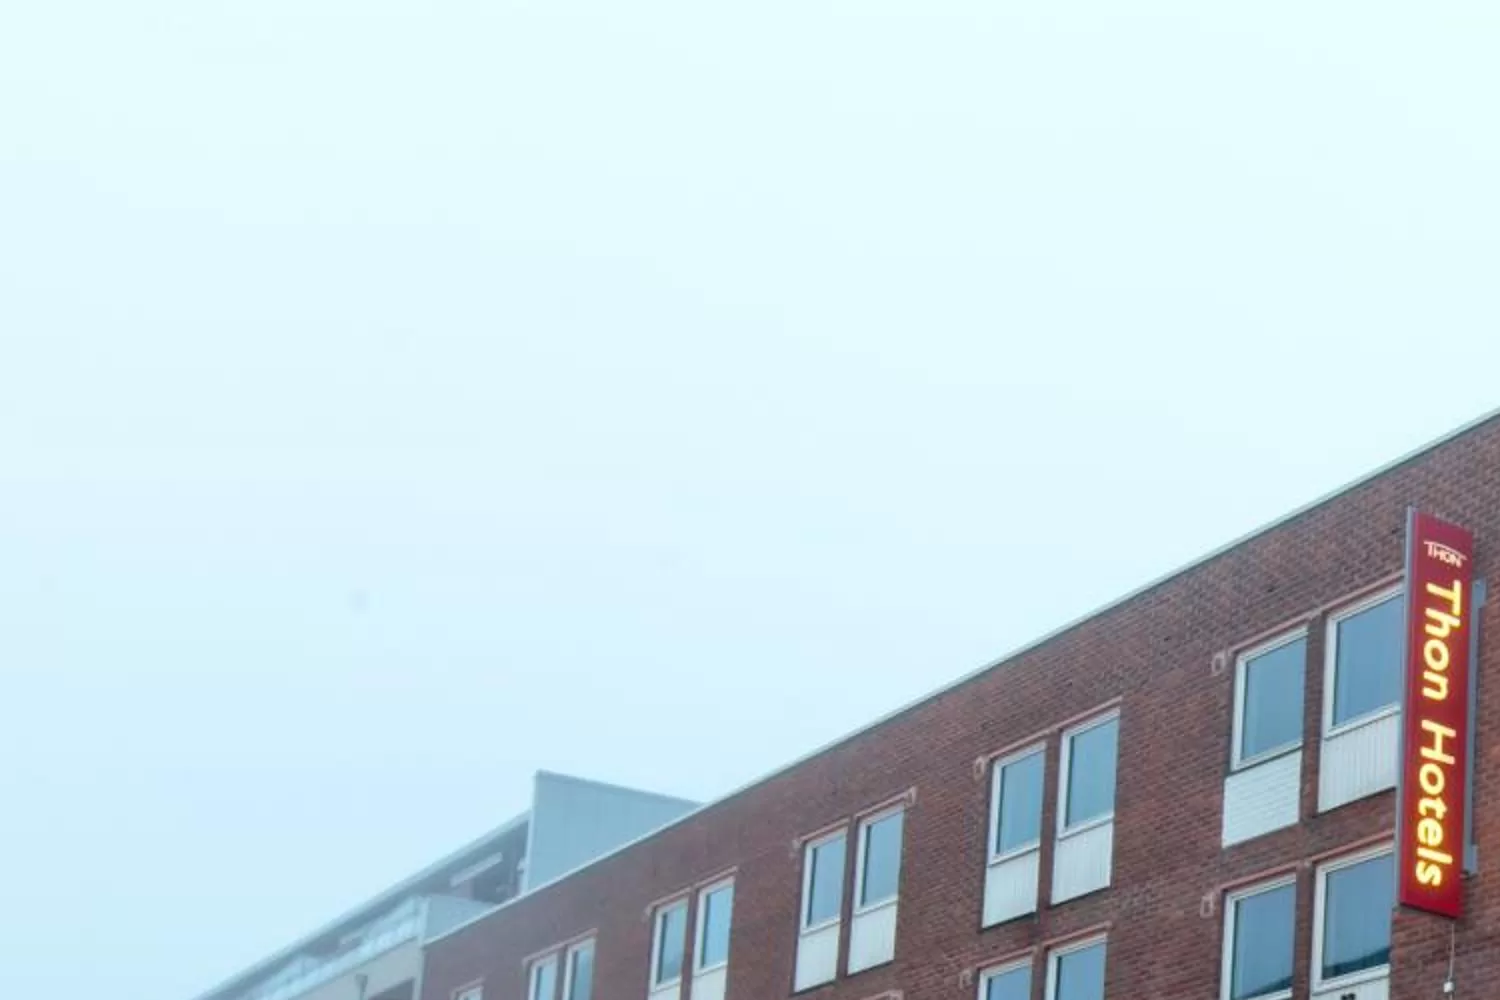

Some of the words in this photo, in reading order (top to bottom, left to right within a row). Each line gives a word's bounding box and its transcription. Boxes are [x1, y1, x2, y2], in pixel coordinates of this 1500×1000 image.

[1424, 540, 1467, 568] THON
[1422, 579, 1462, 701] Thon
[1415, 719, 1457, 887] Hotels
